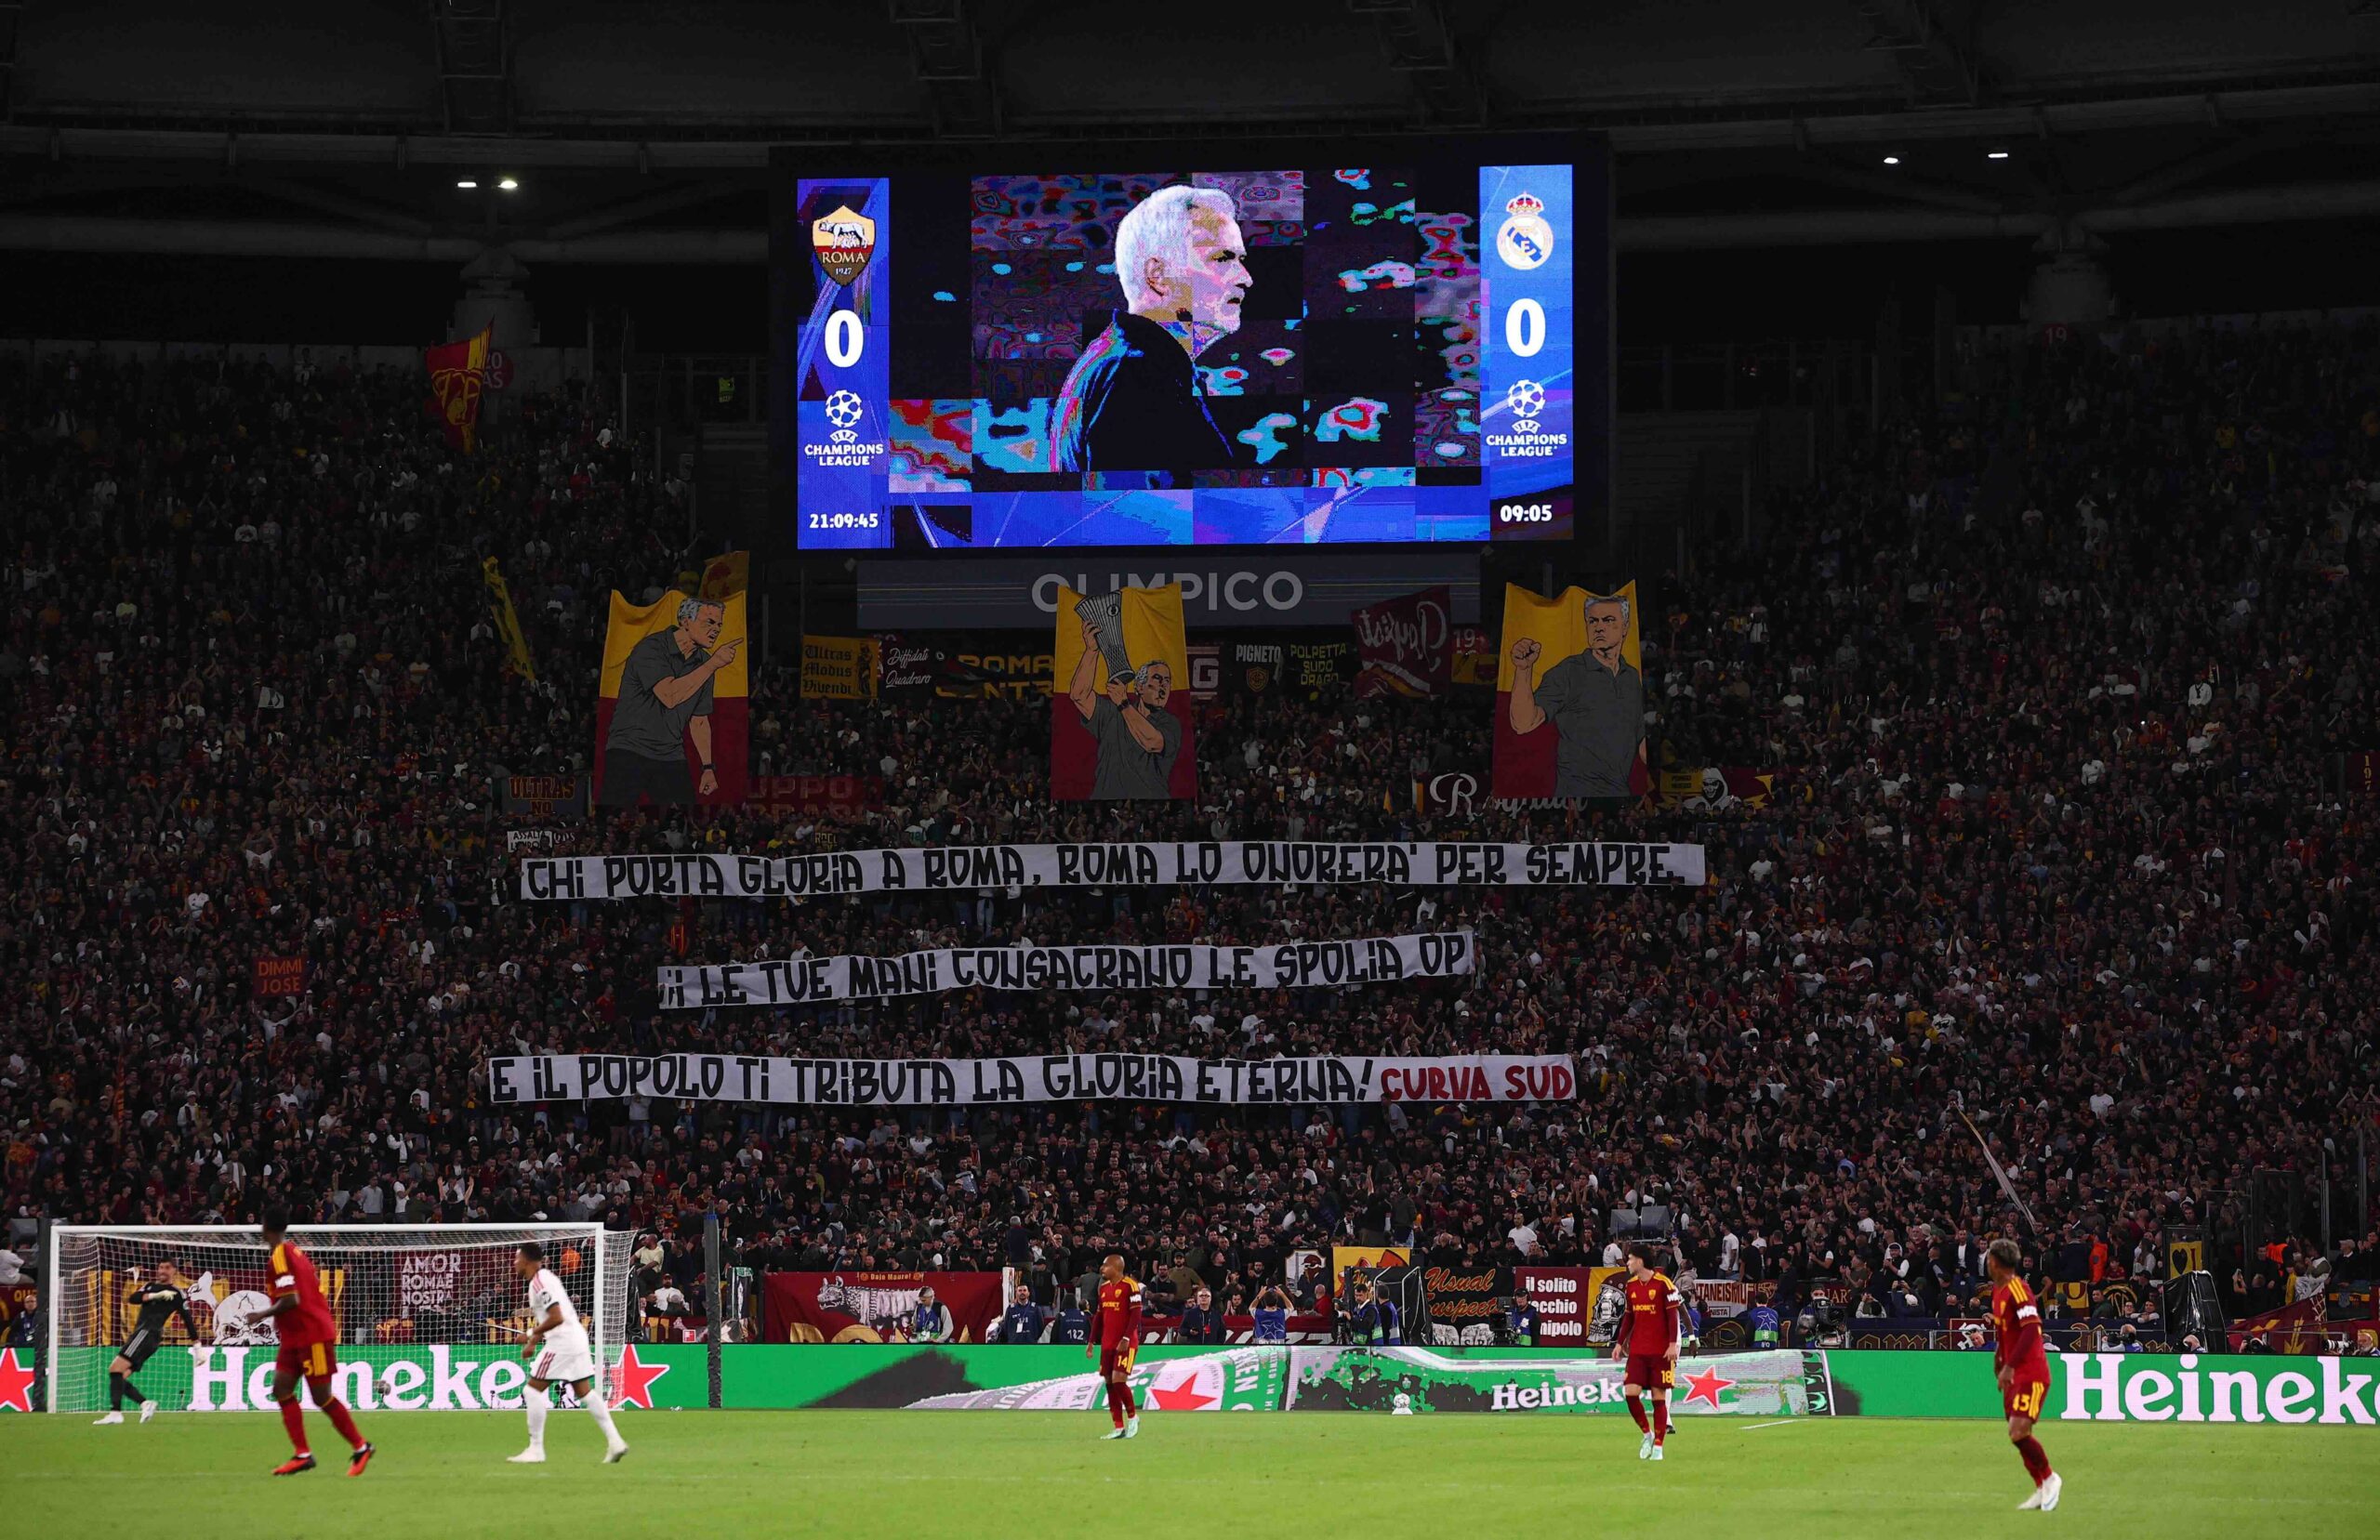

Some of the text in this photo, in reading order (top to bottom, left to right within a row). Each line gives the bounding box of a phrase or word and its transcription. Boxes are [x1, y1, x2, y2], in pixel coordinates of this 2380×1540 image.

[822, 252, 866, 263] ROMA
[1505, 298, 1545, 357] 0
[825, 309, 864, 367] 0
[804, 443, 884, 455] CHAMPIONS
[1486, 434, 1567, 446] CHAMPIONS
[1501, 446, 1554, 456] LEAGUE
[819, 456, 870, 466] LEAGUE
[809, 513, 879, 529] 21:09:45
[1500, 505, 1553, 522] 09:05
[1236, 644, 1281, 663] PIGNETO
[509, 776, 575, 799] ULTRAS
[602, 855, 723, 897] PORTA
[881, 850, 906, 888] A
[922, 847, 1041, 888] ROMA,
[1056, 844, 1157, 884] ROMA
[1176, 843, 1222, 883] LO
[1435, 844, 1506, 884] PER
[258, 958, 303, 977] DIMMI
[700, 967, 747, 1005] LE
[759, 959, 833, 1002] TUE
[951, 948, 1192, 988] CONSACRANO
[1209, 948, 1257, 987] LE
[261, 976, 301, 994] JOSE
[492, 1060, 518, 1101] E
[579, 1056, 723, 1098] POPOLO
[972, 1060, 1023, 1101] LA
[1381, 1065, 1491, 1100] CURVA
[1505, 1065, 1572, 1099] SUD
[403, 1254, 460, 1273] AMOR
[402, 1273, 453, 1291] ROMAE
[1424, 1267, 1496, 1293] Usual
[1537, 1278, 1577, 1293] solito
[402, 1290, 453, 1305] NOSTRA
[1117, 1356, 1127, 1368] 14
[1660, 1370, 1672, 1383] 18
[1491, 1378, 1653, 1410] Heinek
[2060, 1353, 2380, 1425] Heinek
